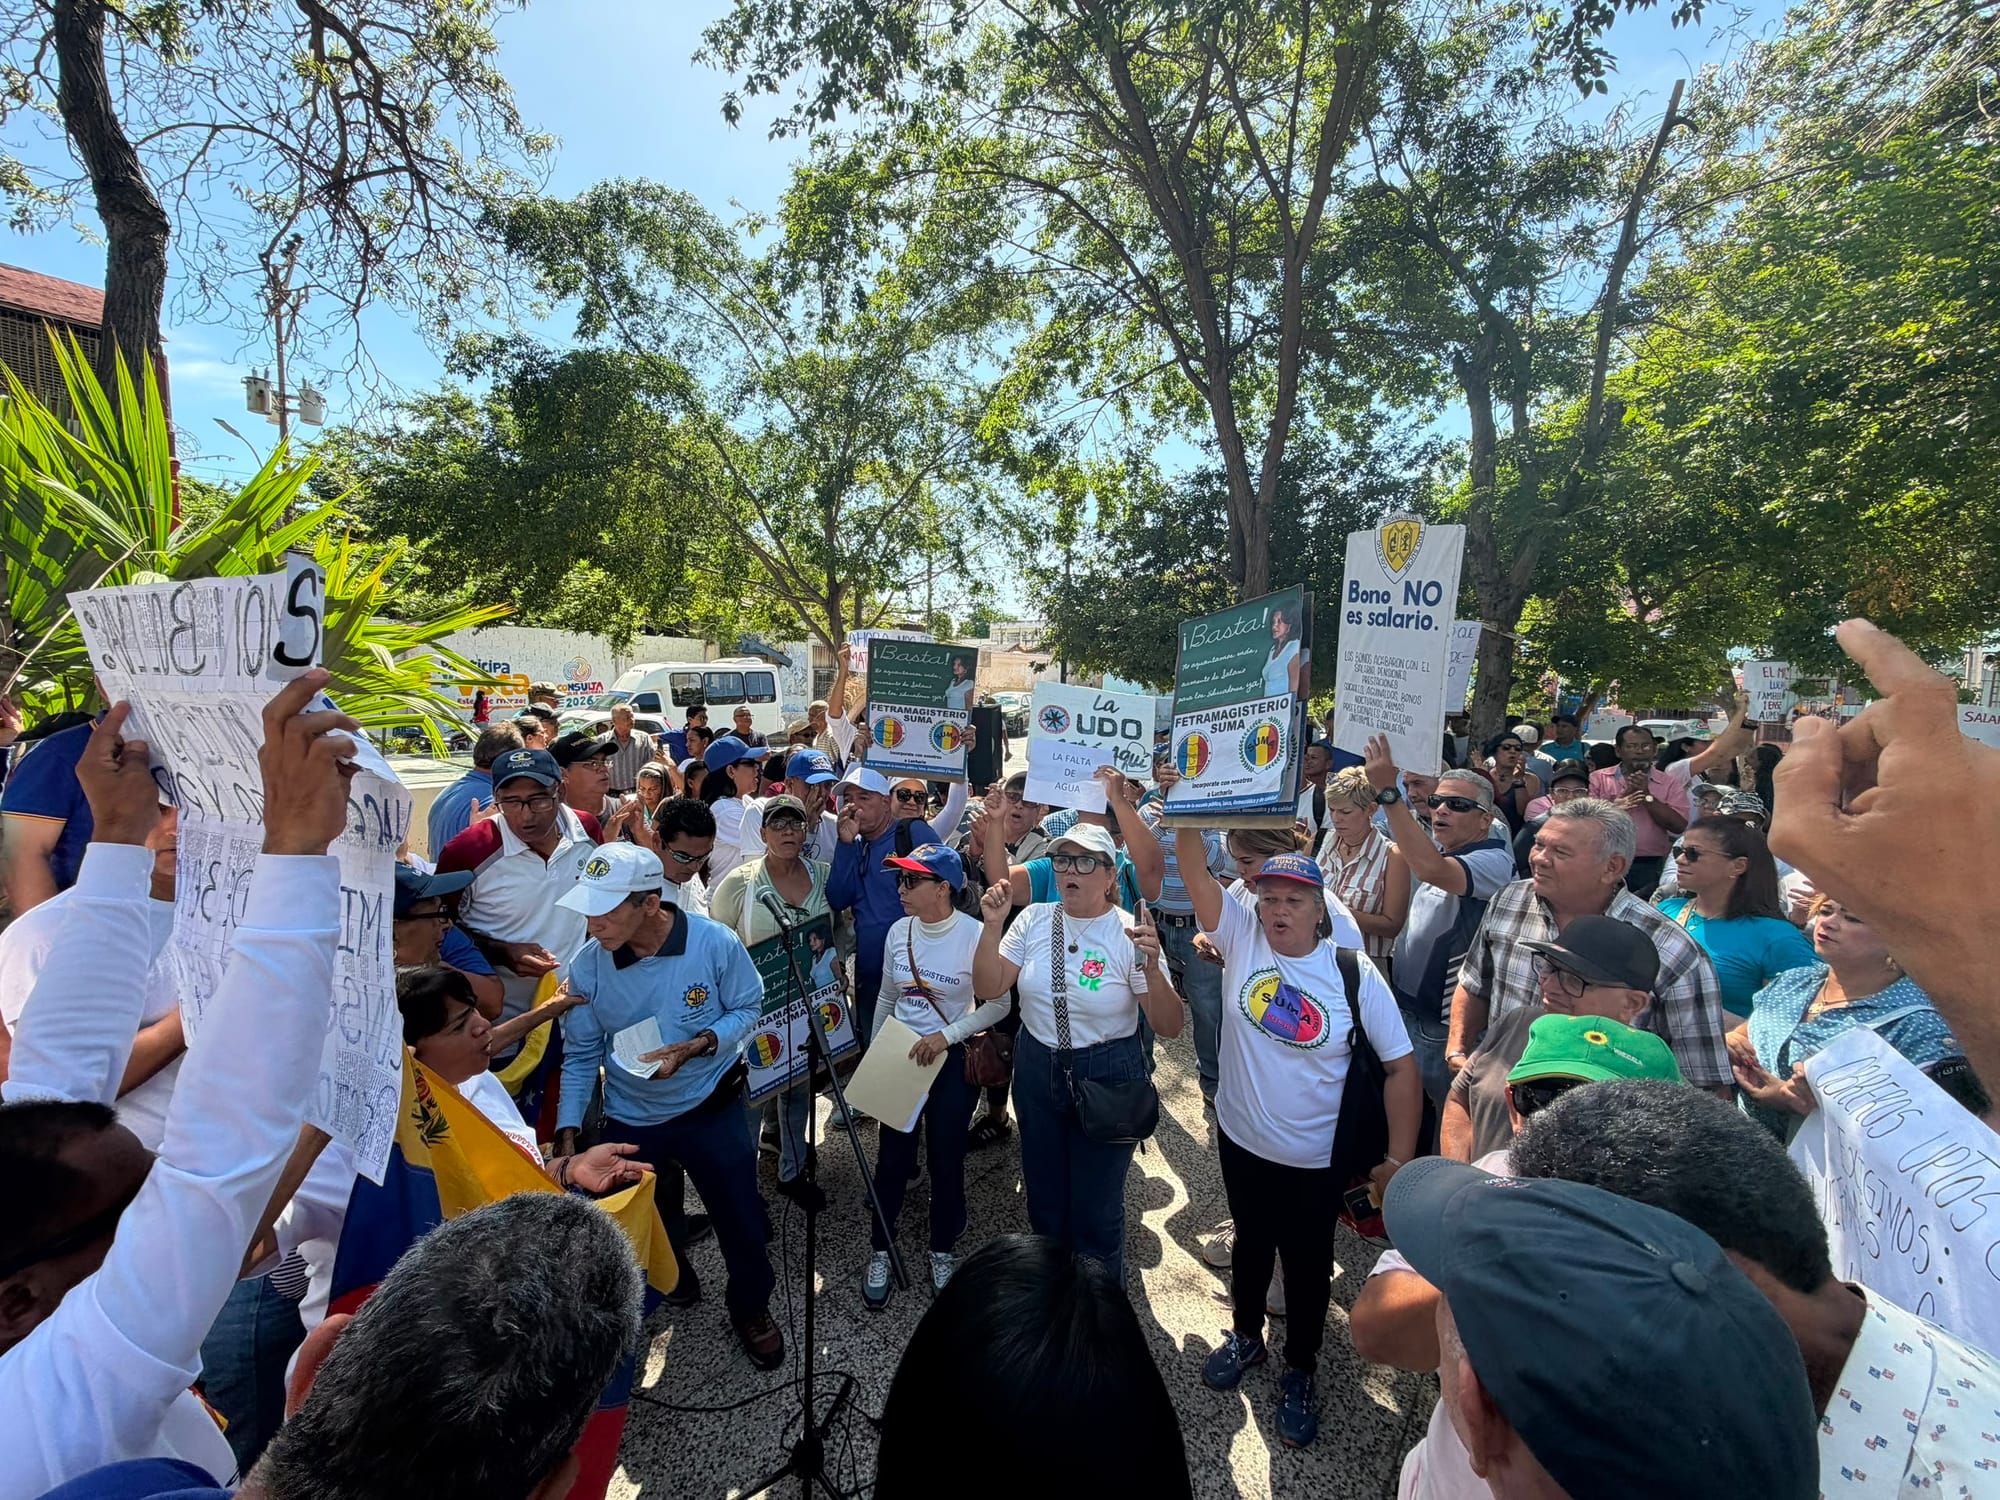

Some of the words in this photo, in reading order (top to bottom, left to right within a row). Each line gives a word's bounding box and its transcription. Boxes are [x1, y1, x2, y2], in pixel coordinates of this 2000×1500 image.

[1348, 580, 1391, 604] Bono
[1403, 580, 1443, 607] NO
[1346, 610, 1363, 625] es
[1367, 606, 1439, 631] salario.
[1183, 607, 1268, 651] ¡Basta!
[873, 644, 950, 666] ¡Basta!
[1344, 650, 1353, 662] LOS
[1355, 652, 1372, 665] BONOS
[1405, 660, 1418, 670] CON
[1421, 661, 1430, 672] EL
[1763, 667, 1774, 678] EL
[557, 681, 604, 692] CONSULTA
[1246, 678, 1263, 693] ya!
[566, 695, 594, 708] 2026
[1093, 694, 1120, 713] La
[1401, 692, 1422, 705] BONOS
[871, 703, 967, 719] FETRAMAGISTERIO
[1175, 698, 1289, 728] FETRAMAGISTERIO
[1963, 710, 2000, 724] SALA
[903, 715, 933, 724] SUMA
[1076, 713, 1142, 740] UDO
[1210, 721, 1245, 734] SUMA
[1052, 753, 1063, 761] LA
[1065, 755, 1091, 767] FALTA
[1064, 768, 1077, 778] DE
[1054, 782, 1081, 793] AGUA
[1262, 993, 1312, 1025] SUMA
